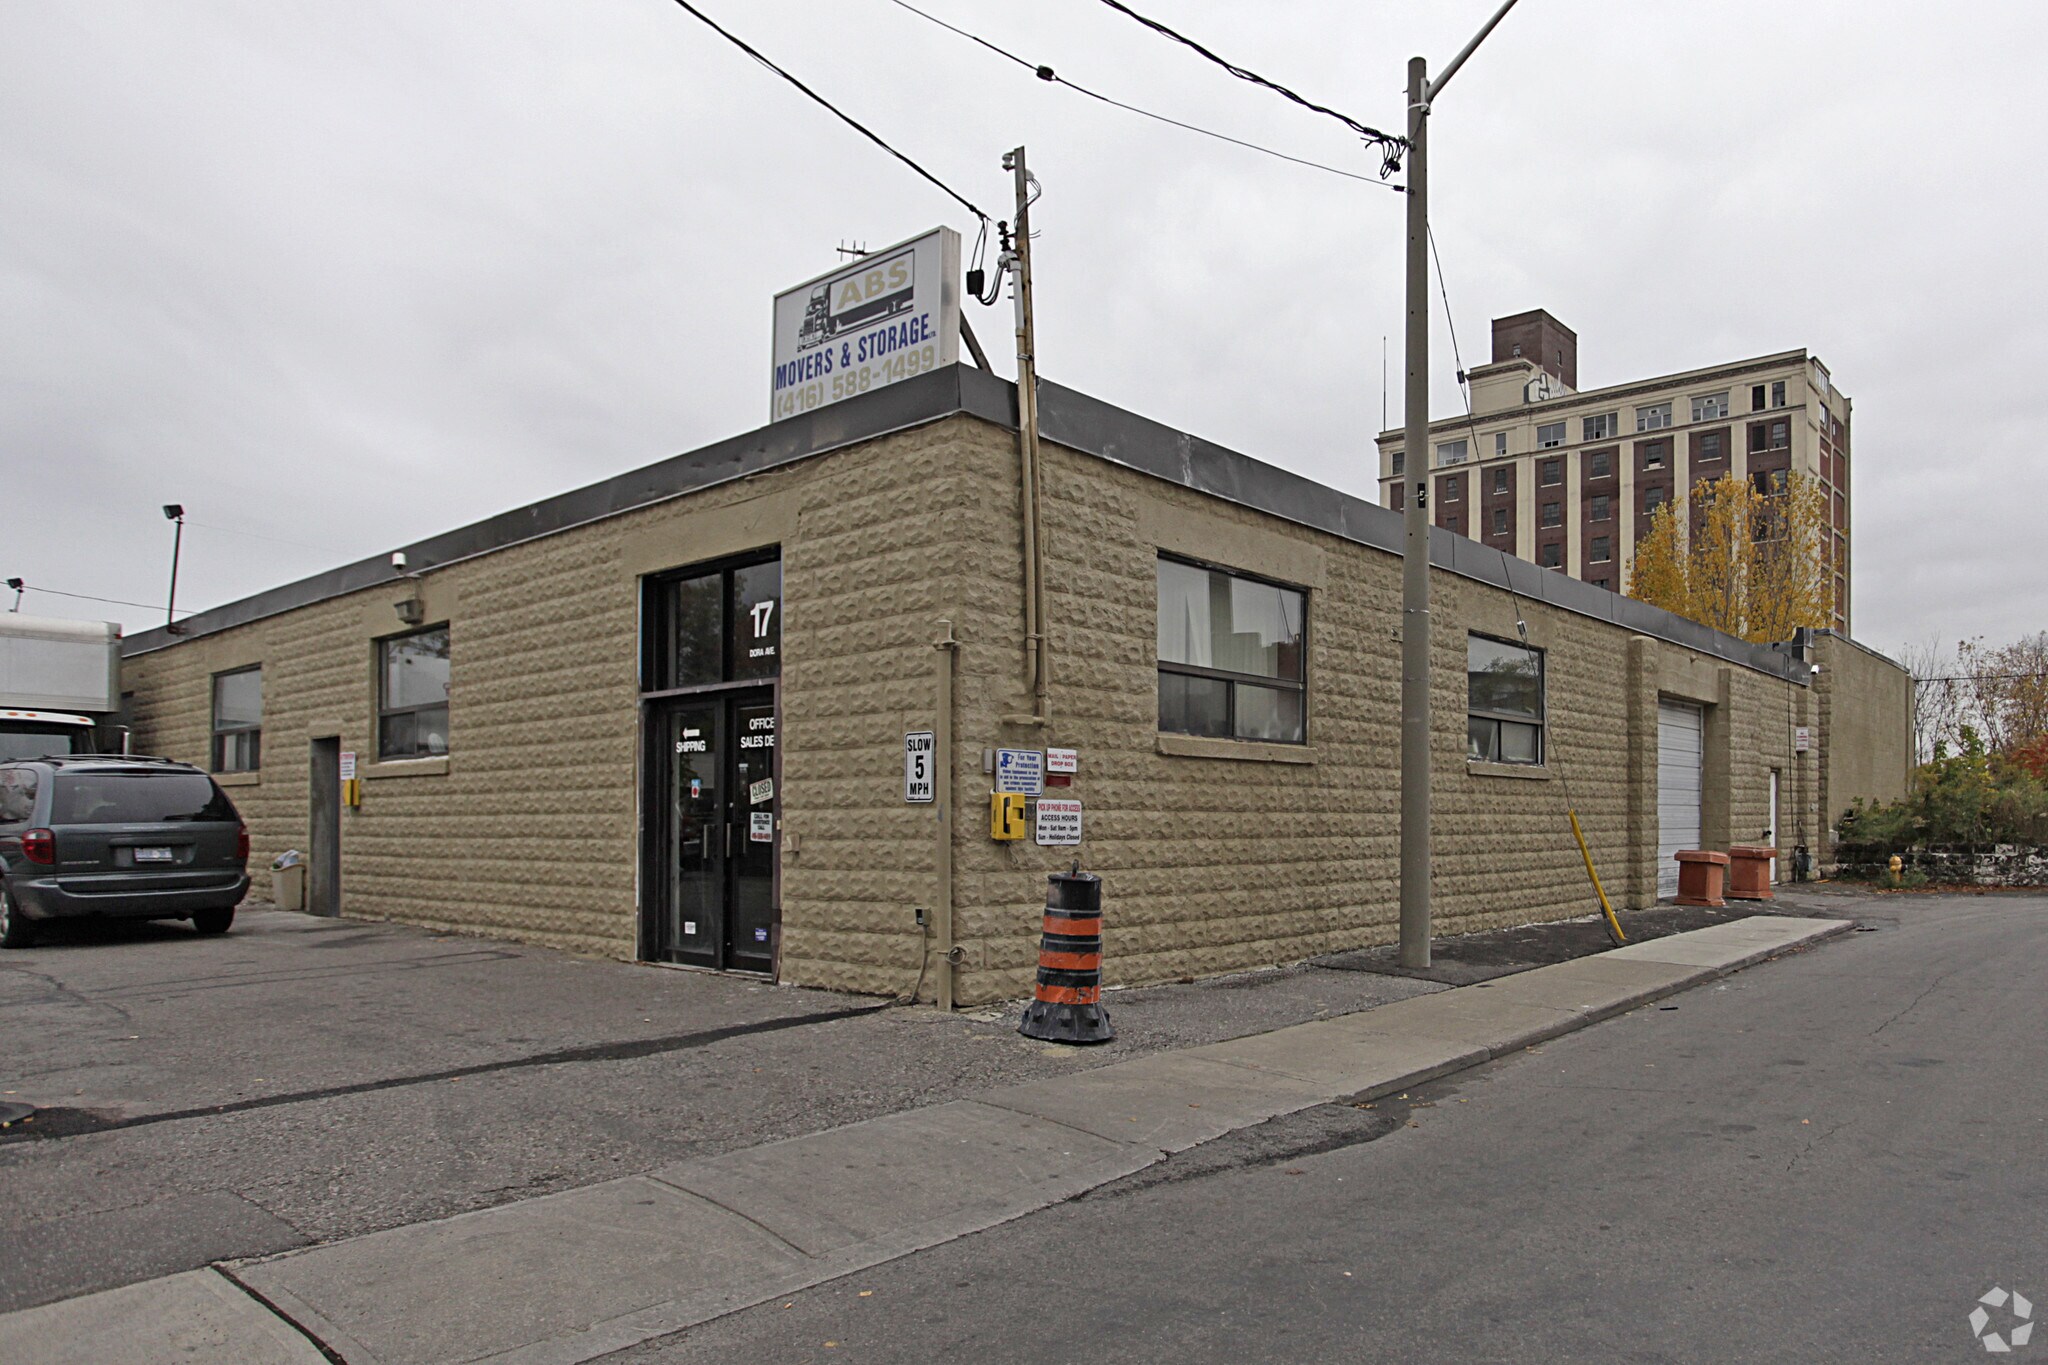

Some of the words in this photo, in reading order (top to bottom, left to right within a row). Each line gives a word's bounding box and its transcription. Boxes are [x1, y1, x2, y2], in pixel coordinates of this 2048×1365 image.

[836, 261, 908, 310] ABS
[775, 347, 833, 391] MOVERS
[840, 341, 851, 368] &
[857, 313, 929, 363] STORAGE
[776, 381, 824, 418] (416)
[831, 345, 935, 401] 588-1499
[750, 600, 774, 638] 17
[749, 648, 764, 658] DORA
[748, 717, 774, 730] OFFICE
[676, 740, 706, 753] SHIPPING
[740, 735, 763, 748] SALES
[907, 738, 931, 752] SLOW
[915, 755, 924, 780] 5
[752, 781, 771, 797] CLOSED
[909, 782, 929, 795] MPH
